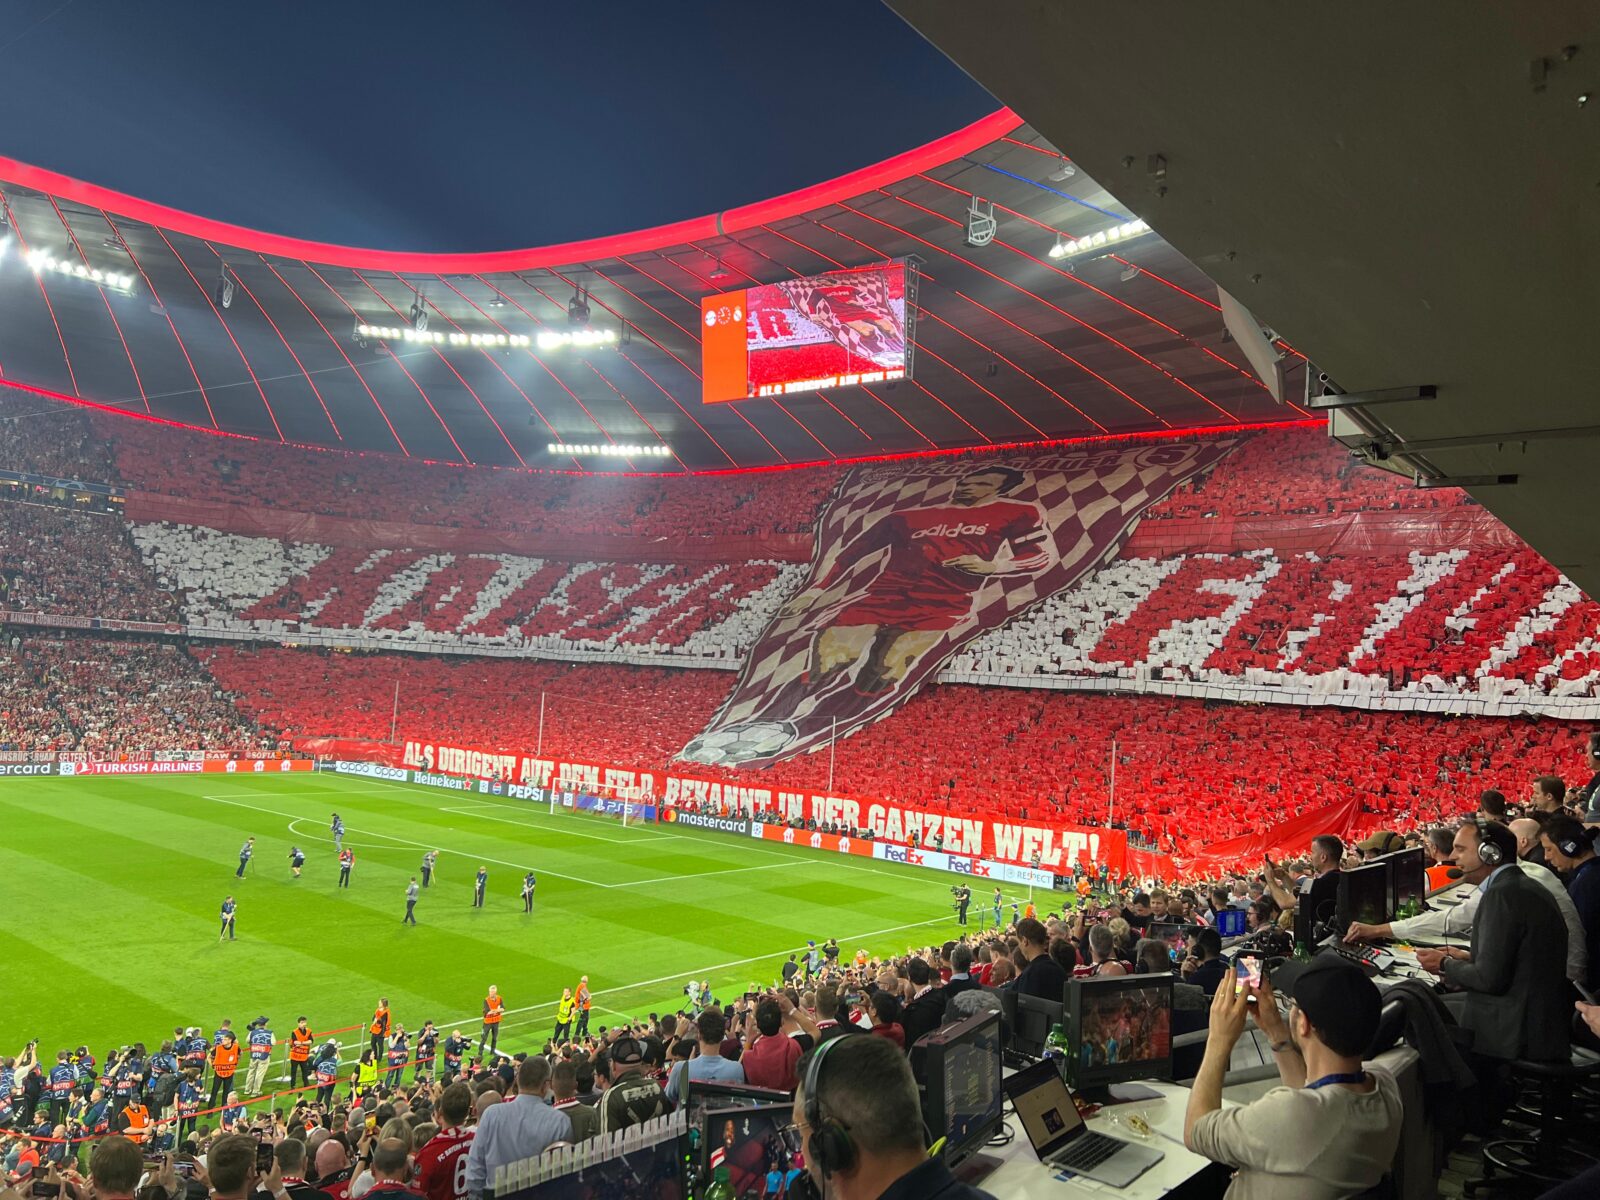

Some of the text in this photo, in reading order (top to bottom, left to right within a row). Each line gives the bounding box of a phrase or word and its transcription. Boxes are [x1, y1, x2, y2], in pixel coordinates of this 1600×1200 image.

[911, 522, 989, 539] adidas
[96, 762, 202, 774] TURKISH AIRLINES
[414, 772, 462, 789] Heineken
[508, 784, 544, 802] PEPSI
[403, 741, 1100, 868] ALS DIRIGENT AUF DEM FELD BEKANNT IN DER GANZEN WELT!
[678, 813, 746, 833] mastercard
[884, 845, 924, 866] FedEx
[948, 856, 990, 877] FedEx
[1016, 871, 1052, 883] RESPECT
